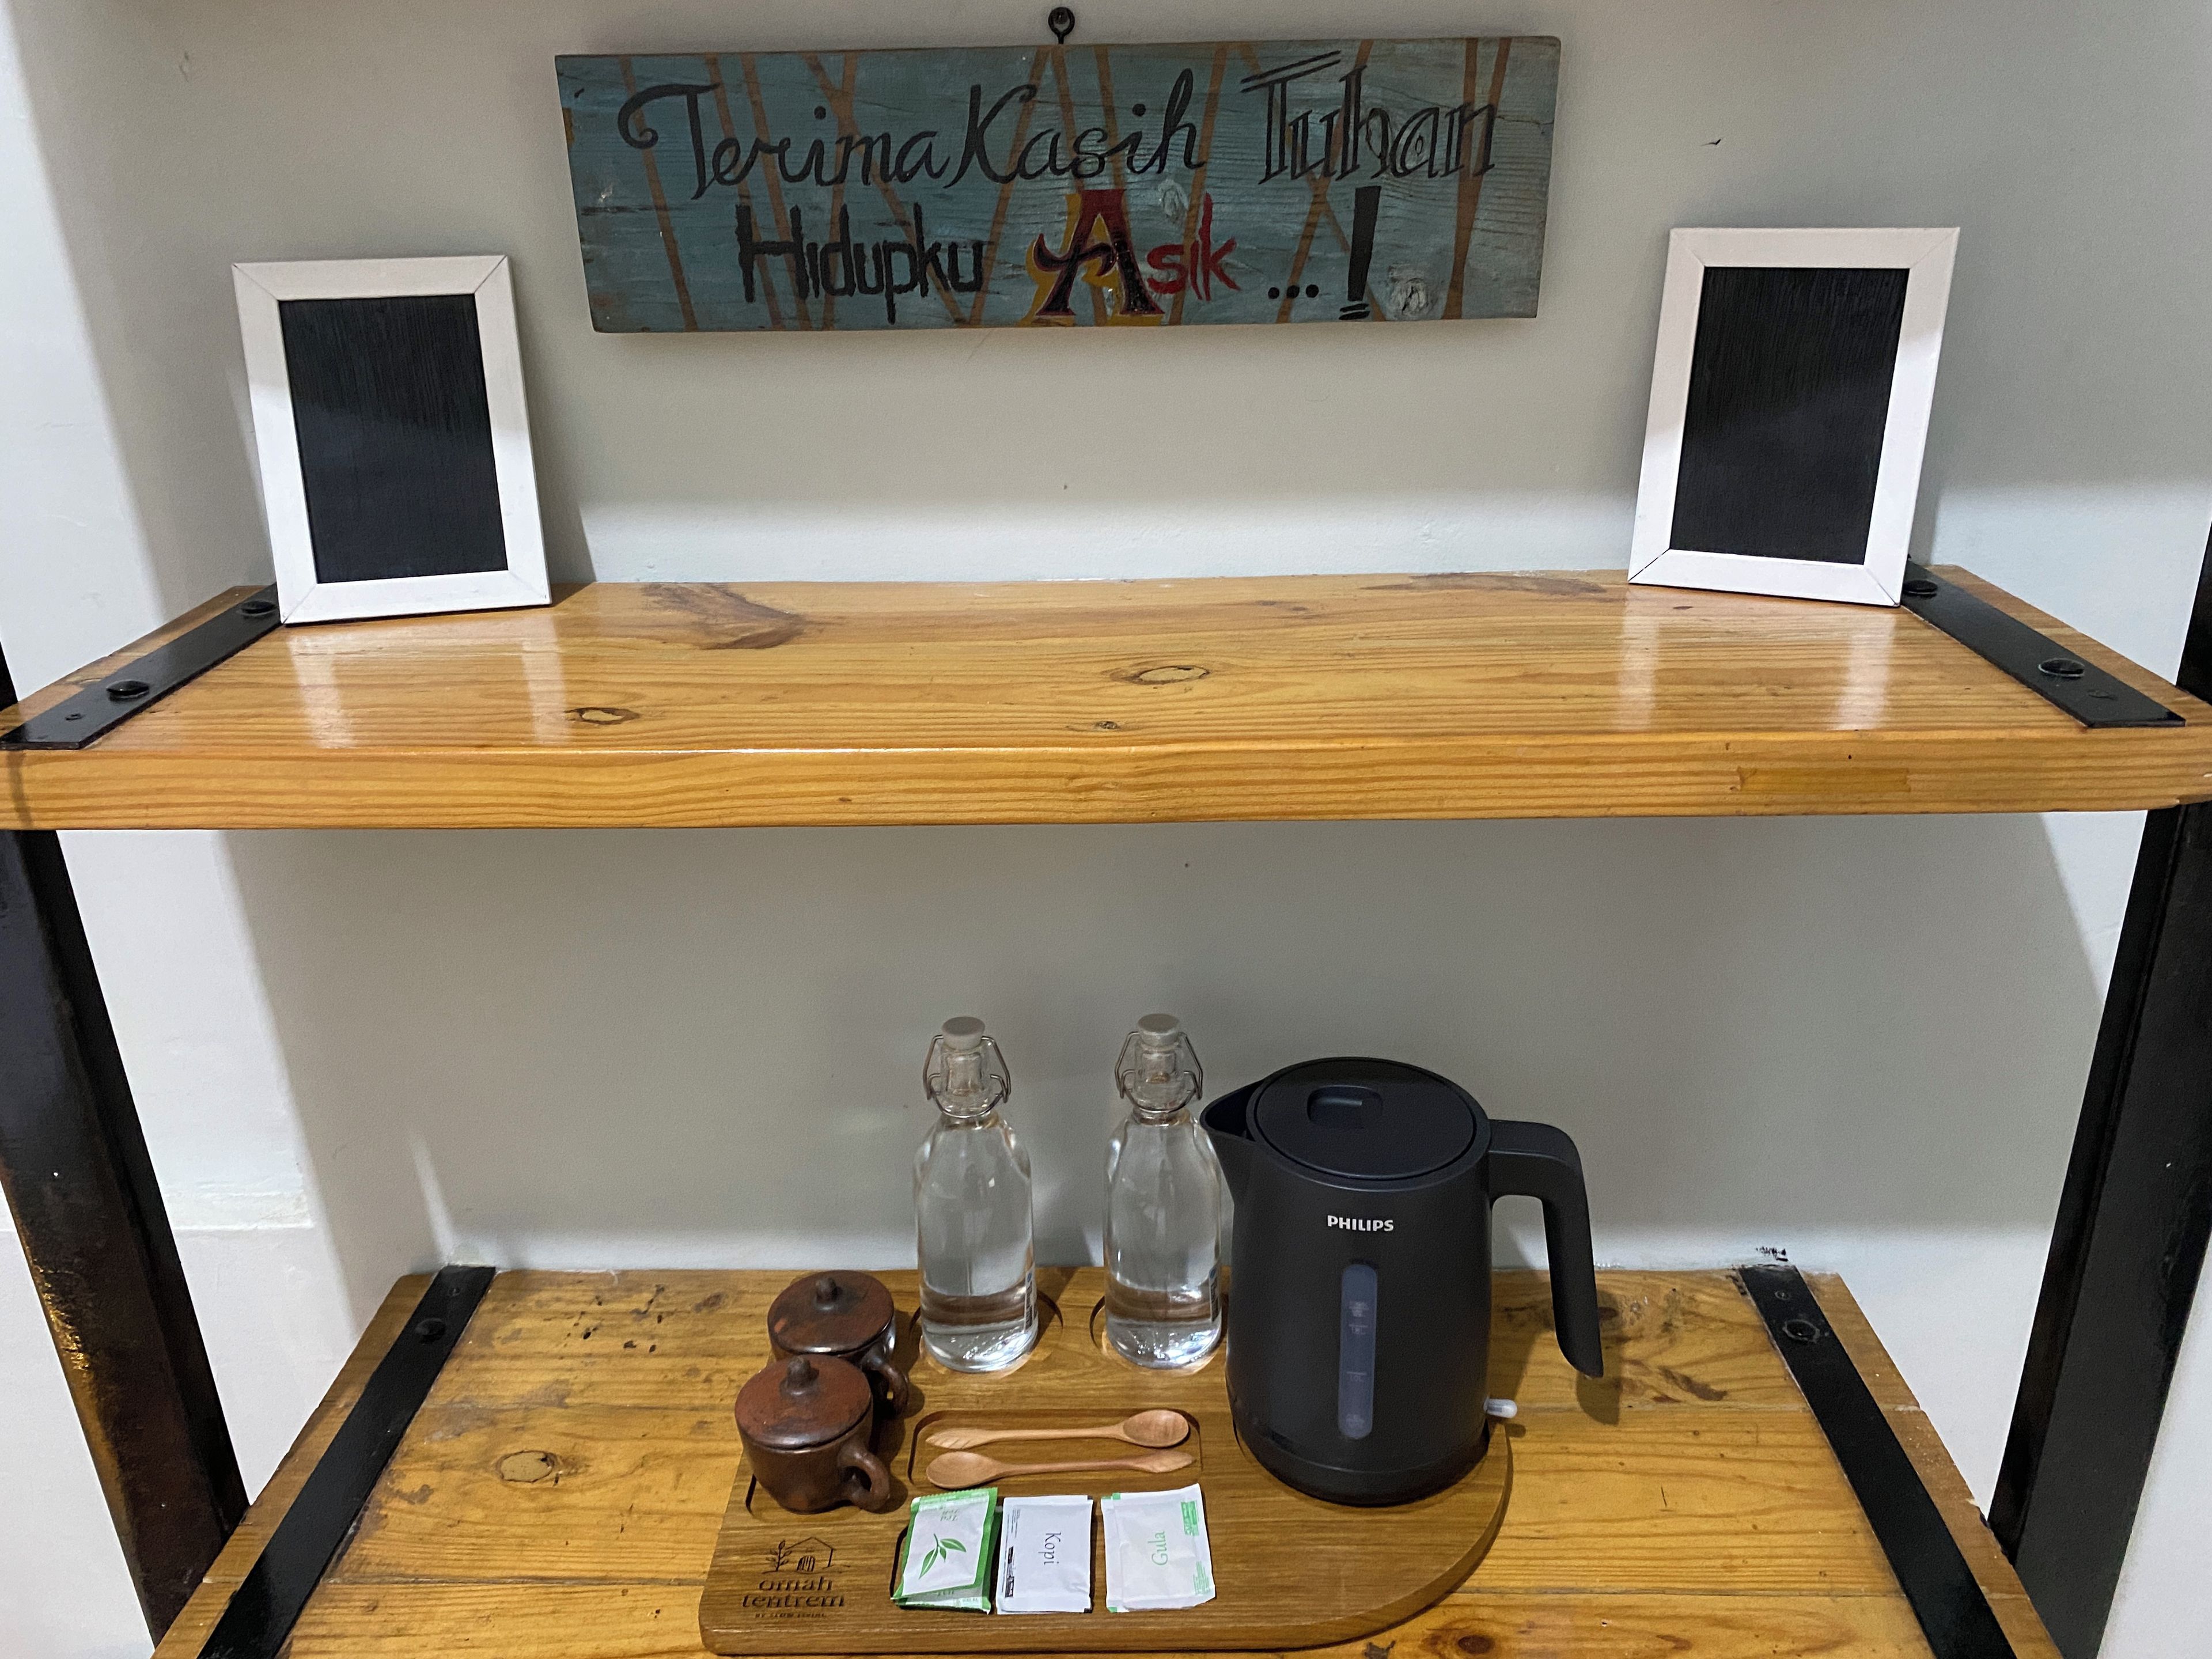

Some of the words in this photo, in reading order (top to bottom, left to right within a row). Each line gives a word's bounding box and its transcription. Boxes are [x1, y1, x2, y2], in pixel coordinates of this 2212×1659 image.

[618, 83, 950, 200] Terima
[943, 67, 1207, 188] Kasih
[1240, 50, 1498, 185] Tuhan
[734, 203, 991, 324] Hidupku
[1327, 1215, 1394, 1232] PHILIPS
[1038, 1532, 1061, 1565] Kopi
[1147, 1531, 1168, 1566] Gula
[758, 1576, 833, 1591] omah
[742, 1593, 846, 1608] tentrem
